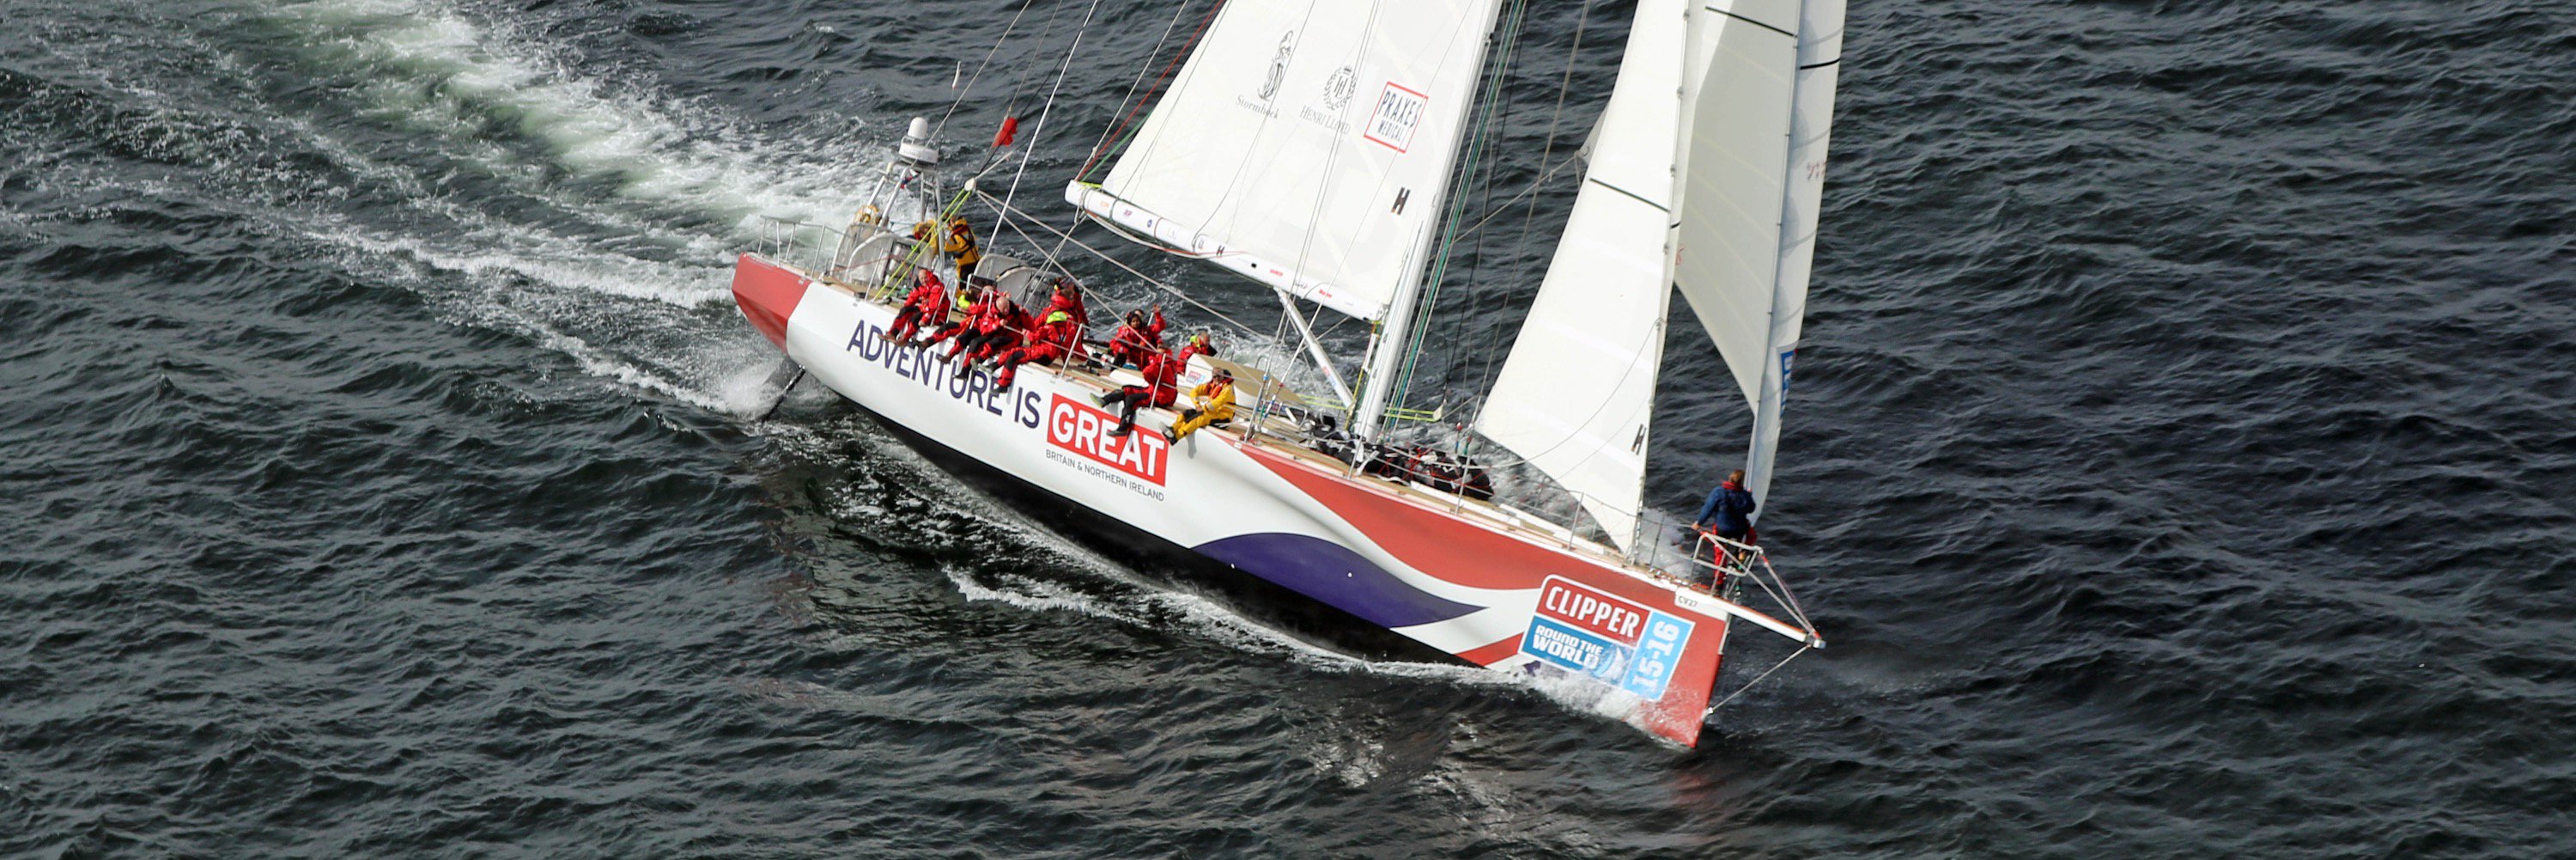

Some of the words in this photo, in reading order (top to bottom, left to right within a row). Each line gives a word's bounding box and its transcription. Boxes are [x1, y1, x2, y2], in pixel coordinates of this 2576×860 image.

[1377, 90, 1422, 128] PRAXES
[1377, 119, 1404, 142] MEDICAL
[847, 320, 1002, 416] ADVENTURE
[1014, 387, 1042, 429] IS
[1051, 403, 1165, 478] GREAT
[1046, 449, 1076, 467] BRITAIN
[1084, 465, 1127, 488] NORTHERN
[1129, 482, 1164, 502] IRELAND
[1546, 586, 1641, 637] CLIPPER
[1533, 634, 1601, 669] WORLD
[1535, 625, 1580, 648] ROUND
[1581, 641, 1604, 655] THE
[1633, 620, 1680, 692] 15-16
